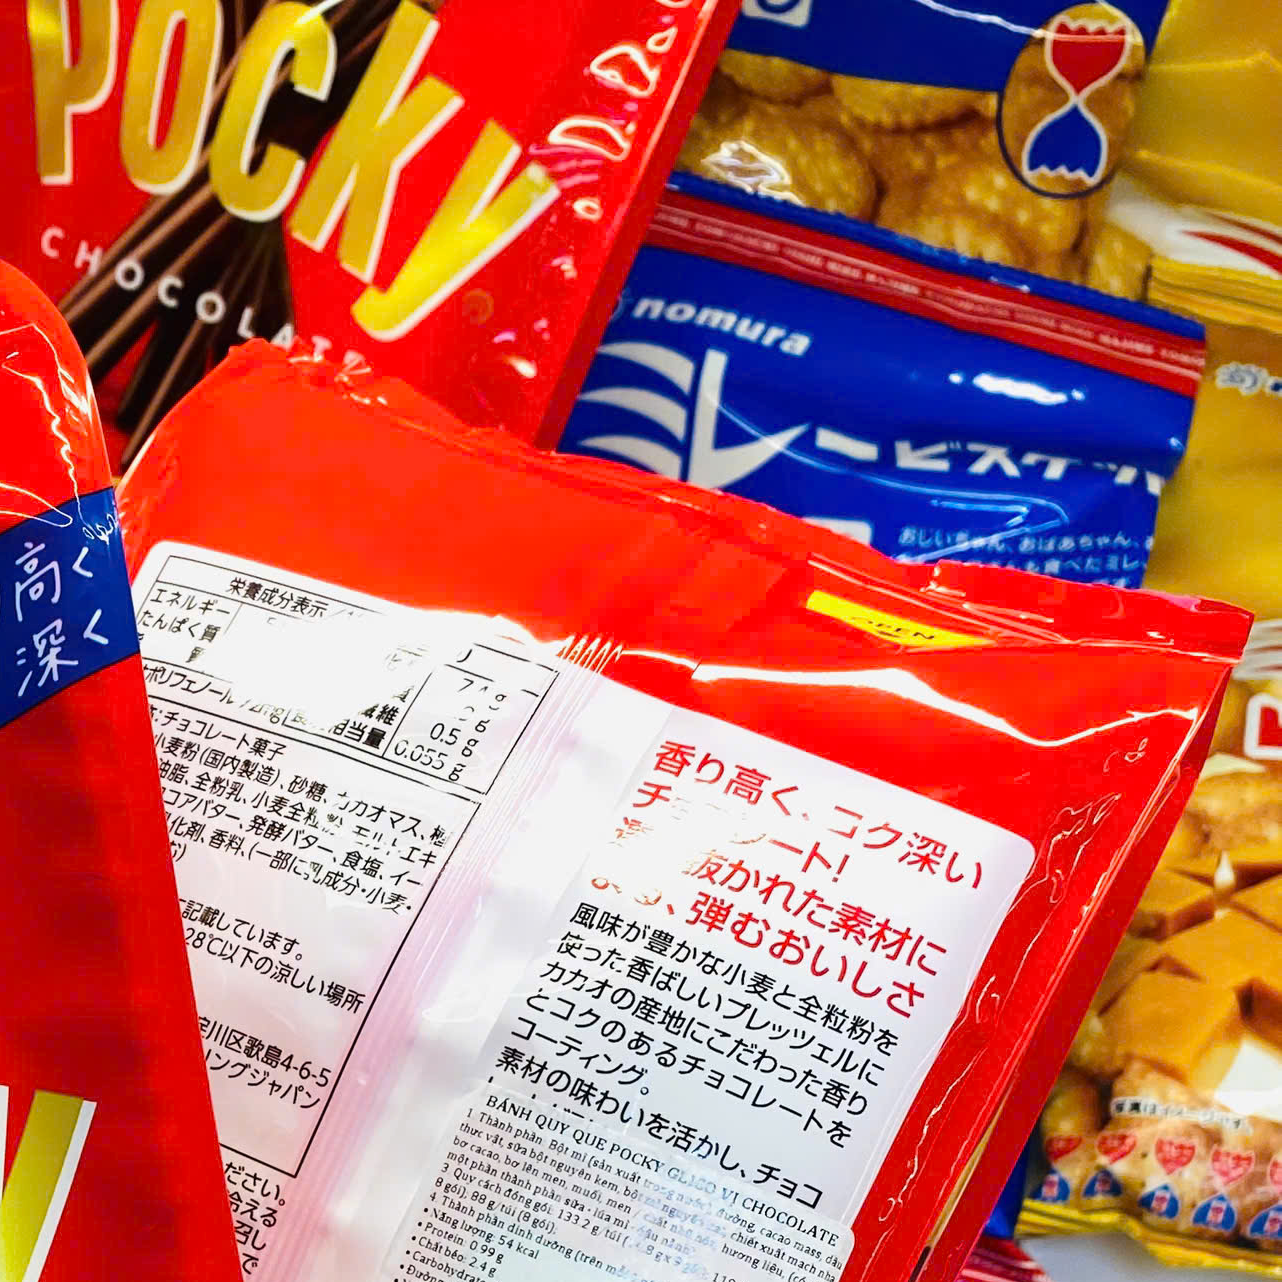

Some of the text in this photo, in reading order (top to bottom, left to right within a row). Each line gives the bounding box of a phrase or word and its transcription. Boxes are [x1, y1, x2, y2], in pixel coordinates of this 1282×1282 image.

[631, 295, 813, 357] nomura
[143, 665, 234, 705] ポリフェノール
[429, 723, 461, 745] 0.5
[178, 897, 304, 962] 記載しています。
[510, 1018, 652, 1097] コーティング。
[485, 1095, 840, 1247] BÁNH QUY QUE POCKY VỊ CHOCOLATE
[434, 1176, 444, 1188] 8
[470, 1190, 488, 1205] 88
[605, 1198, 632, 1215] men
[497, 1234, 515, 1250] 54
[759, 1227, 792, 1246] cacao
